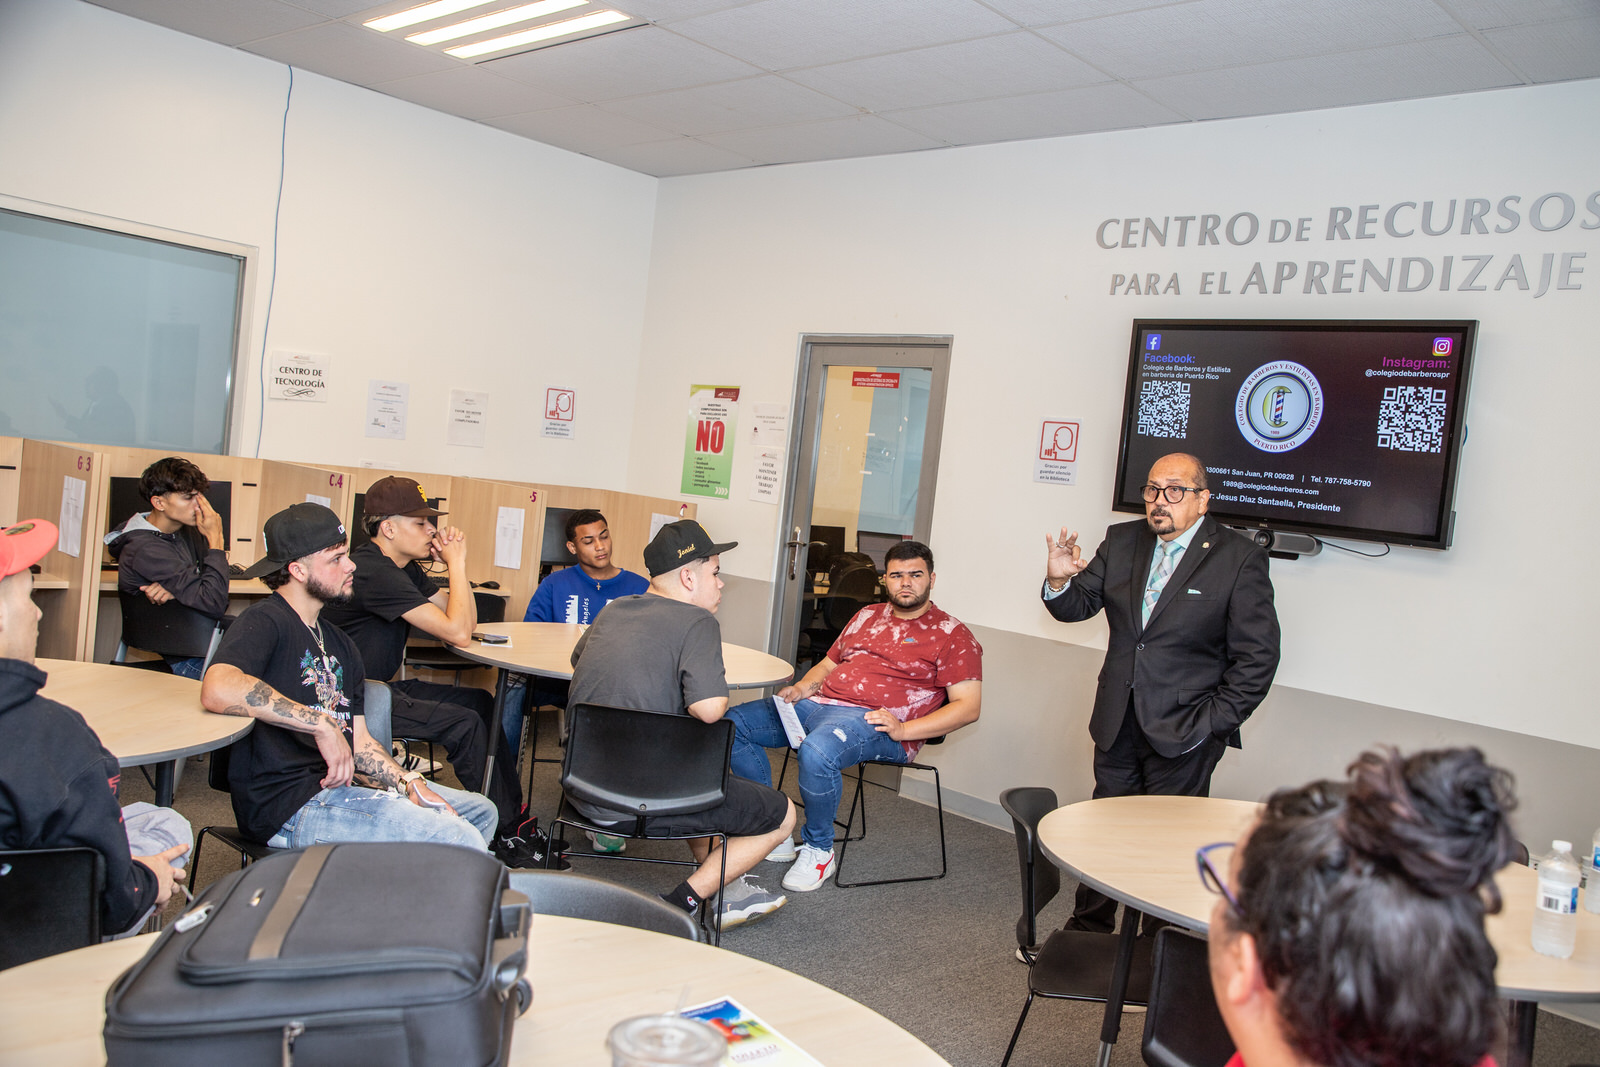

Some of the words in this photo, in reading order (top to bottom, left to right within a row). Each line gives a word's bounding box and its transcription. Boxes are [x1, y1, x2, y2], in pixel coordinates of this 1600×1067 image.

[1096, 212, 1259, 249] CENTRO
[1268, 217, 1312, 243] DE
[1326, 190, 1600, 240] RECURSOS
[1110, 273, 1181, 295] PARA
[1199, 272, 1231, 294] EL
[1240, 252, 1587, 298] APRENDIZAJE
[1144, 353, 1196, 364] Facebook:
[1382, 356, 1451, 370] Instagram:
[279, 366, 311, 375] CENTRO
[1143, 364, 1165, 372] Colegio
[1174, 365, 1201, 373] Barberos
[1247, 363, 1279, 386] BARBEROS
[1365, 369, 1450, 379] @colegiodebarberospr
[275, 377, 326, 388] TECNOLOGÍA
[696, 420, 725, 453] NO
[1253, 438, 1279, 450] PUERTO
[1279, 440, 1296, 450] RICO
[1231, 469, 1244, 477] San
[1244, 470, 1263, 478] Juan,
[1274, 473, 1295, 481] 00928
[1311, 475, 1323, 483] Tel.
[1324, 477, 1372, 488] 787-758-5790
[1222, 481, 1320, 495] 1989@colegiodebarberos.com
[1216, 492, 1238, 502] Jesus
[1239, 495, 1256, 504] Diaz
[1257, 496, 1296, 509] Santaella,
[1297, 500, 1341, 512] Presidente
[581, 597, 591, 625] Angeles
